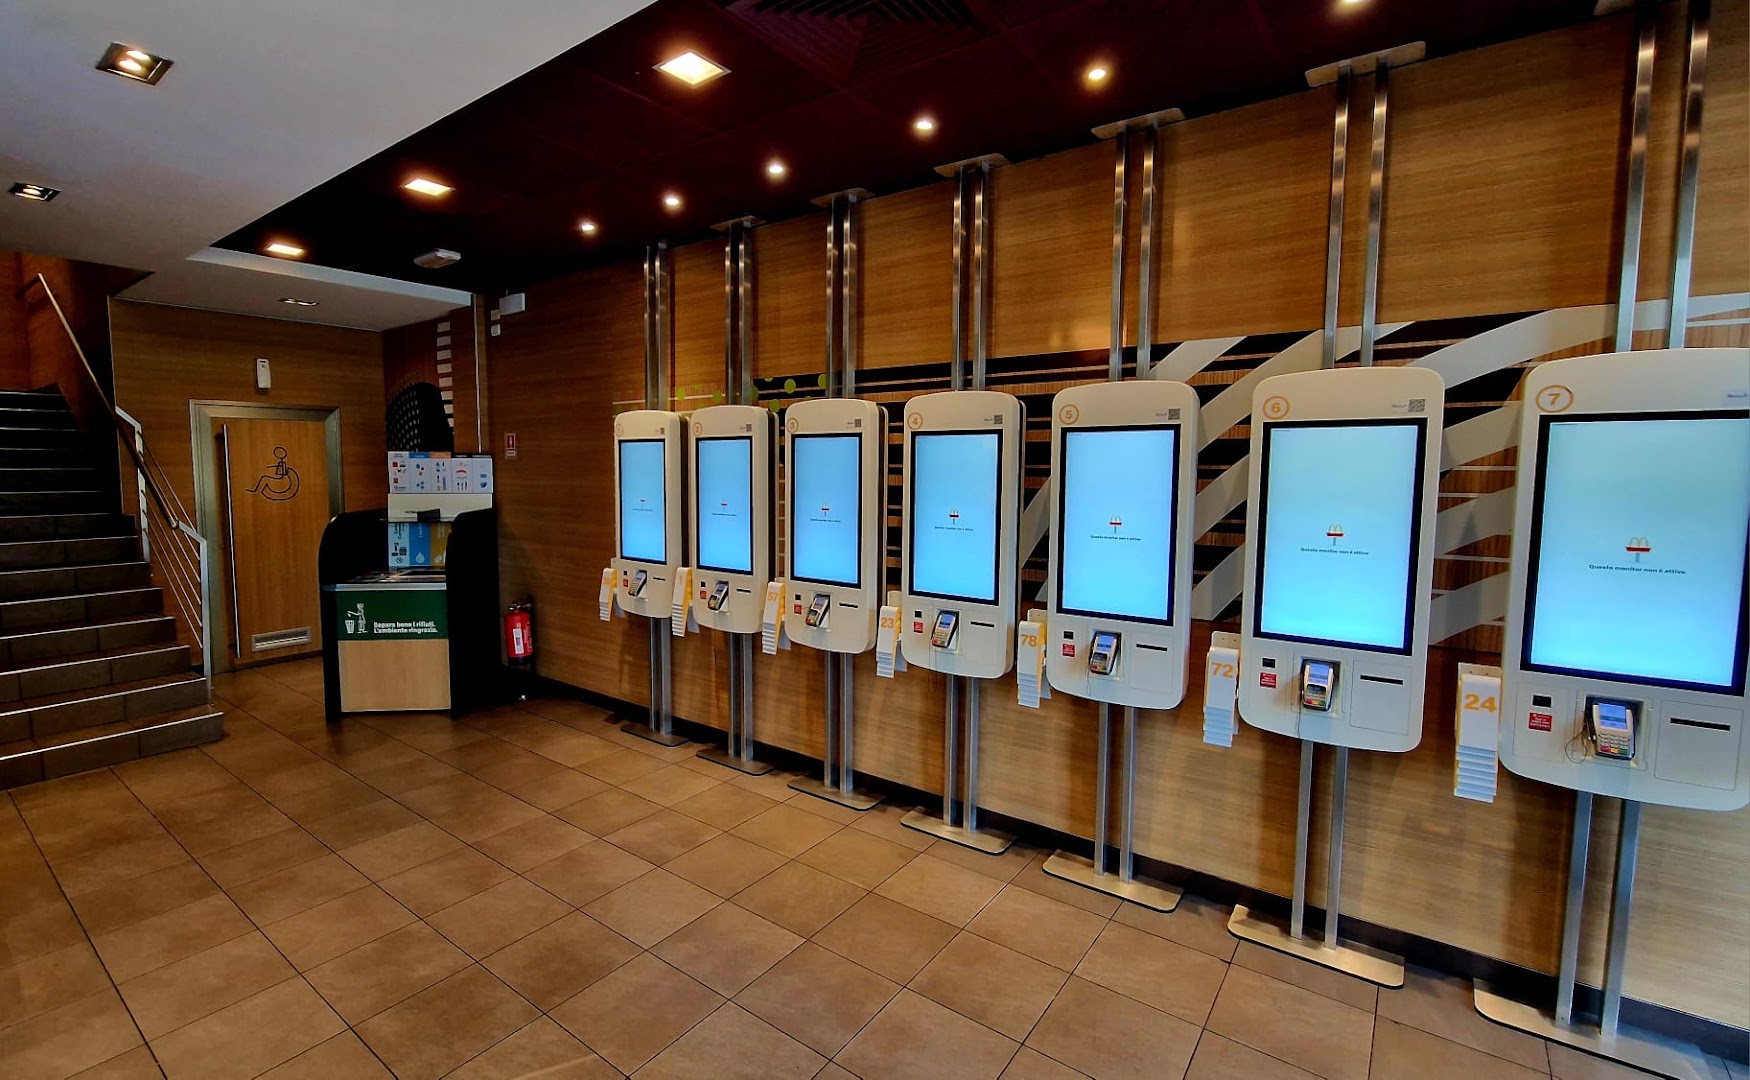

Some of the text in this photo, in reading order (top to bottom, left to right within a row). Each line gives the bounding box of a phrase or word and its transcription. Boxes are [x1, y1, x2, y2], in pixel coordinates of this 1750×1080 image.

[1547, 393, 1562, 406] 7
[1271, 402, 1281, 414] 6
[881, 617, 894, 628] 23
[1020, 634, 1037, 647] 78
[1211, 662, 1233, 679] 72
[1463, 693, 1497, 713] 24
